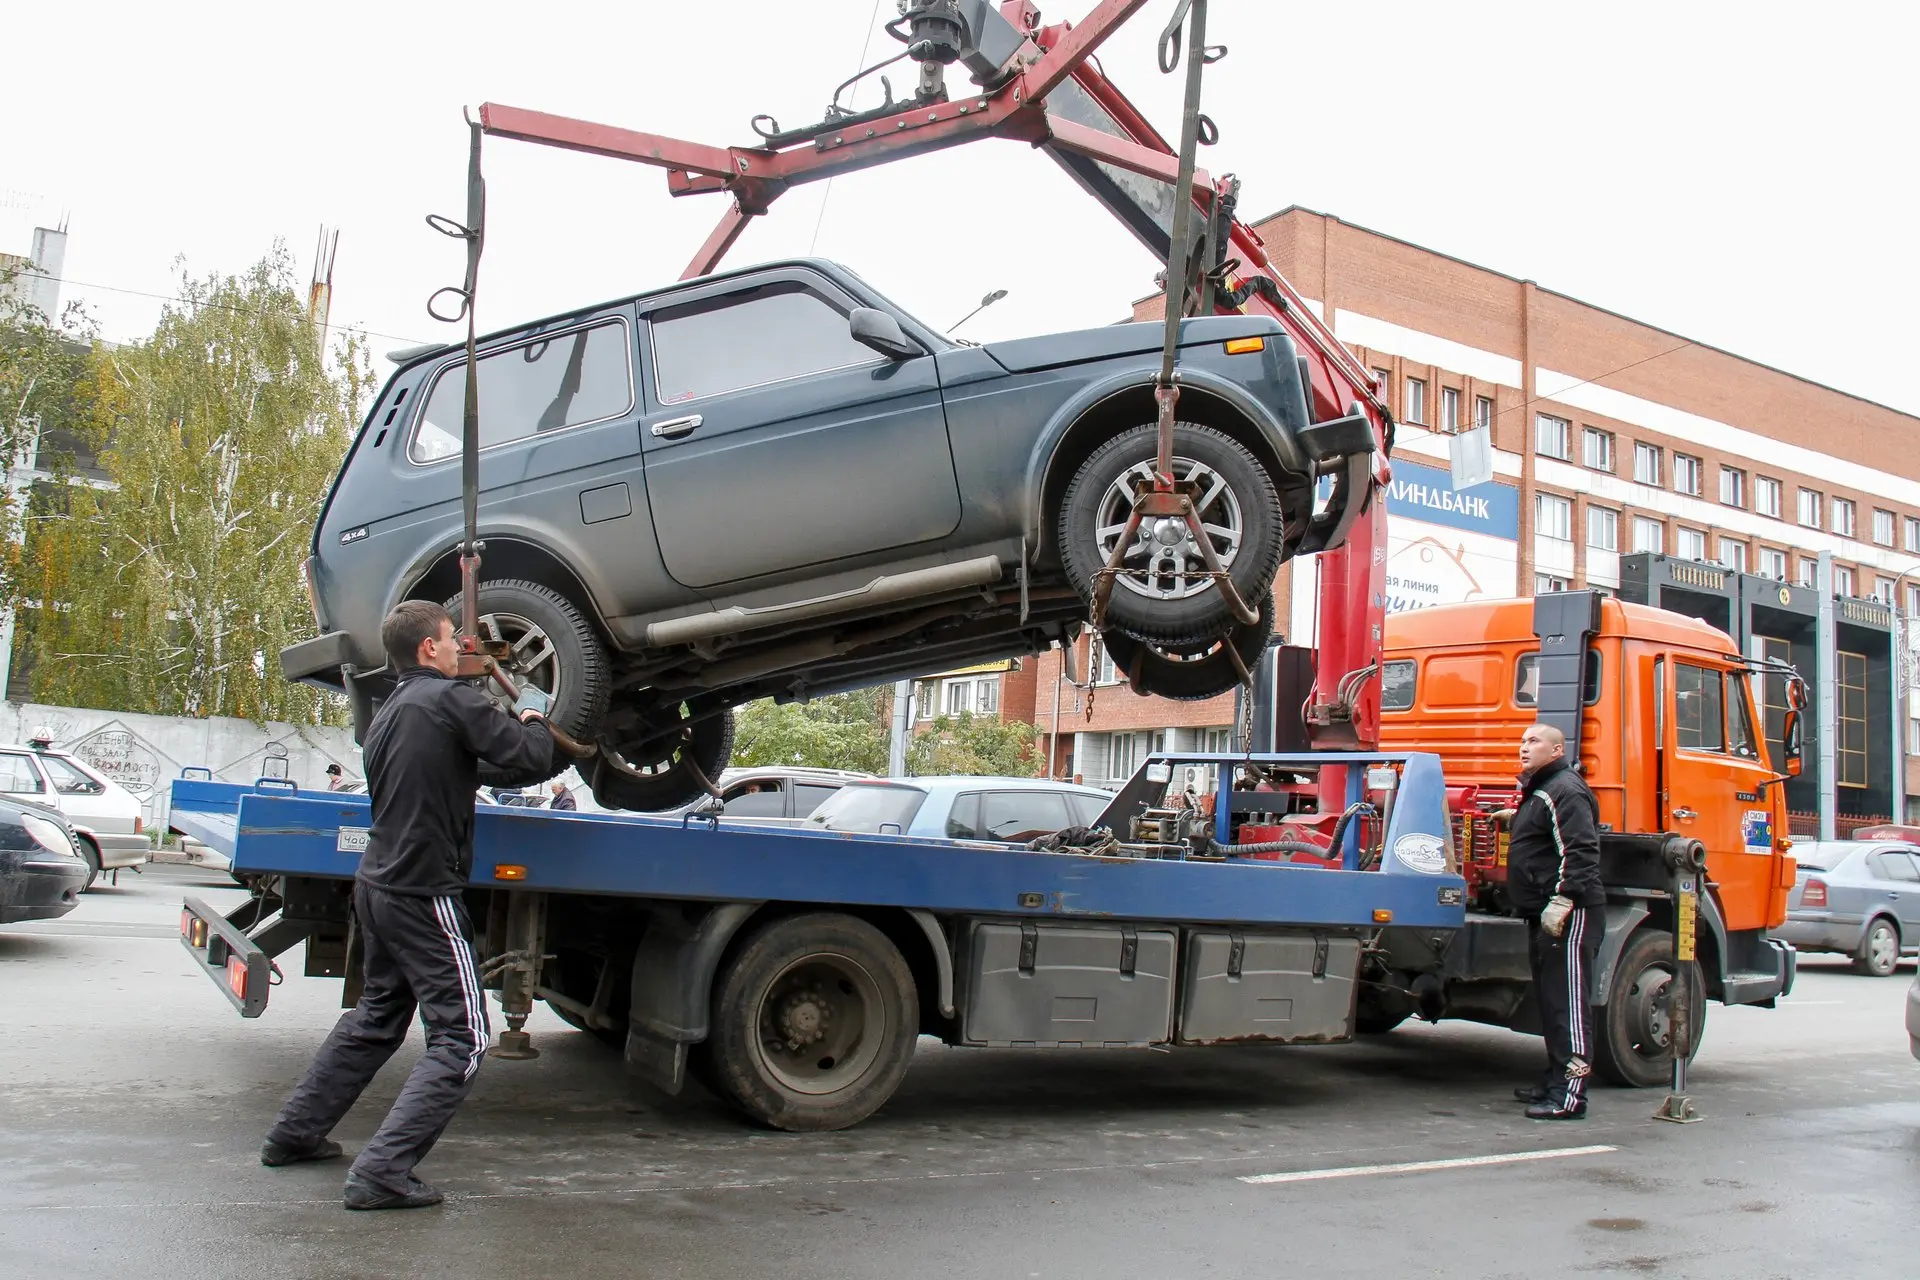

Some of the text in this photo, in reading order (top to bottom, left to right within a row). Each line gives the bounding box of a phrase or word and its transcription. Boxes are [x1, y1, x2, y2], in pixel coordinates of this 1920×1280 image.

[1385, 480, 1489, 519] ЛИНДБАНК
[1385, 575, 1439, 594] ая линия
